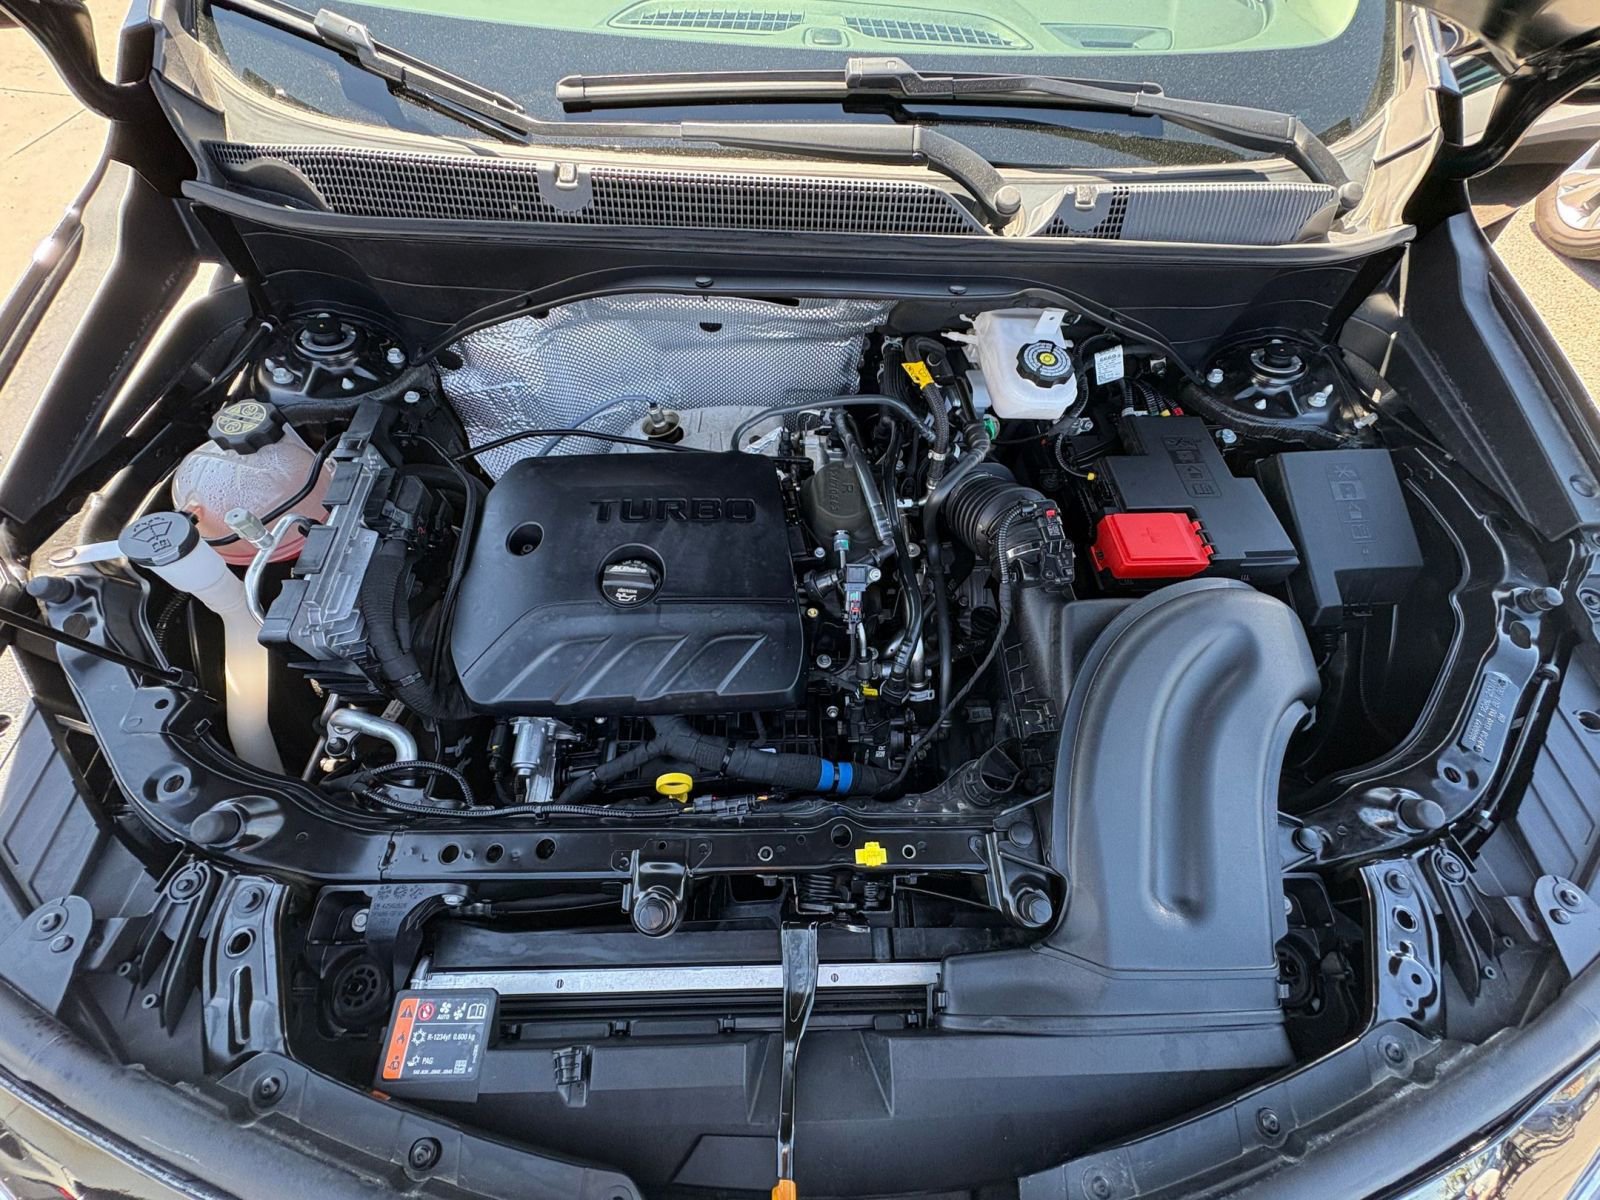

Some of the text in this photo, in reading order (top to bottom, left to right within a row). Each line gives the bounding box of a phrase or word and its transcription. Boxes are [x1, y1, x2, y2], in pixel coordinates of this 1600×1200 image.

[590, 498, 756, 523] TURBO
[427, 1033, 451, 1042] R-1234yf
[468, 1033, 476, 1042] kg
[422, 1057, 434, 1065] PAG
